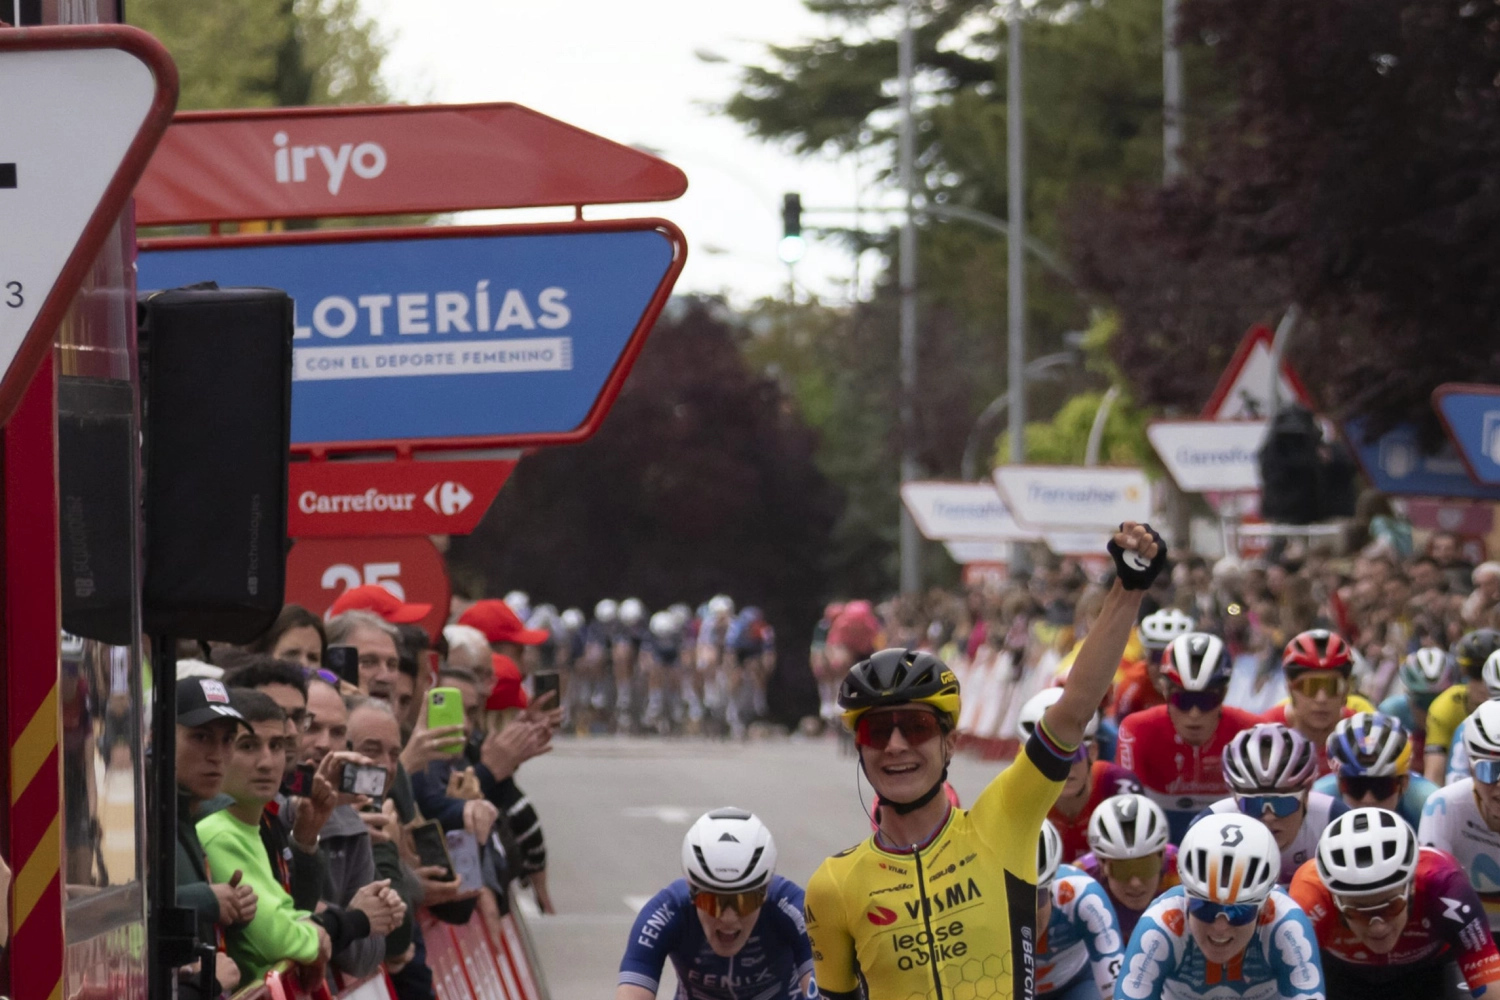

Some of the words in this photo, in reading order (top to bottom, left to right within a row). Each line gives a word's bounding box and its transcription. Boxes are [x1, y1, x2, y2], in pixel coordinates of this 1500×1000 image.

[273, 131, 387, 196] iryo
[293, 280, 572, 339] LOTERÍAS
[305, 357, 344, 372] CON
[351, 356, 369, 369] EL
[376, 352, 453, 369] DEPORTE
[461, 349, 554, 364] FEMENINO
[299, 488, 416, 514] Carrefour
[904, 877, 982, 920] VISMA
[638, 902, 675, 949] FENIX
[892, 920, 964, 952] lease
[688, 967, 771, 988] FENIX
